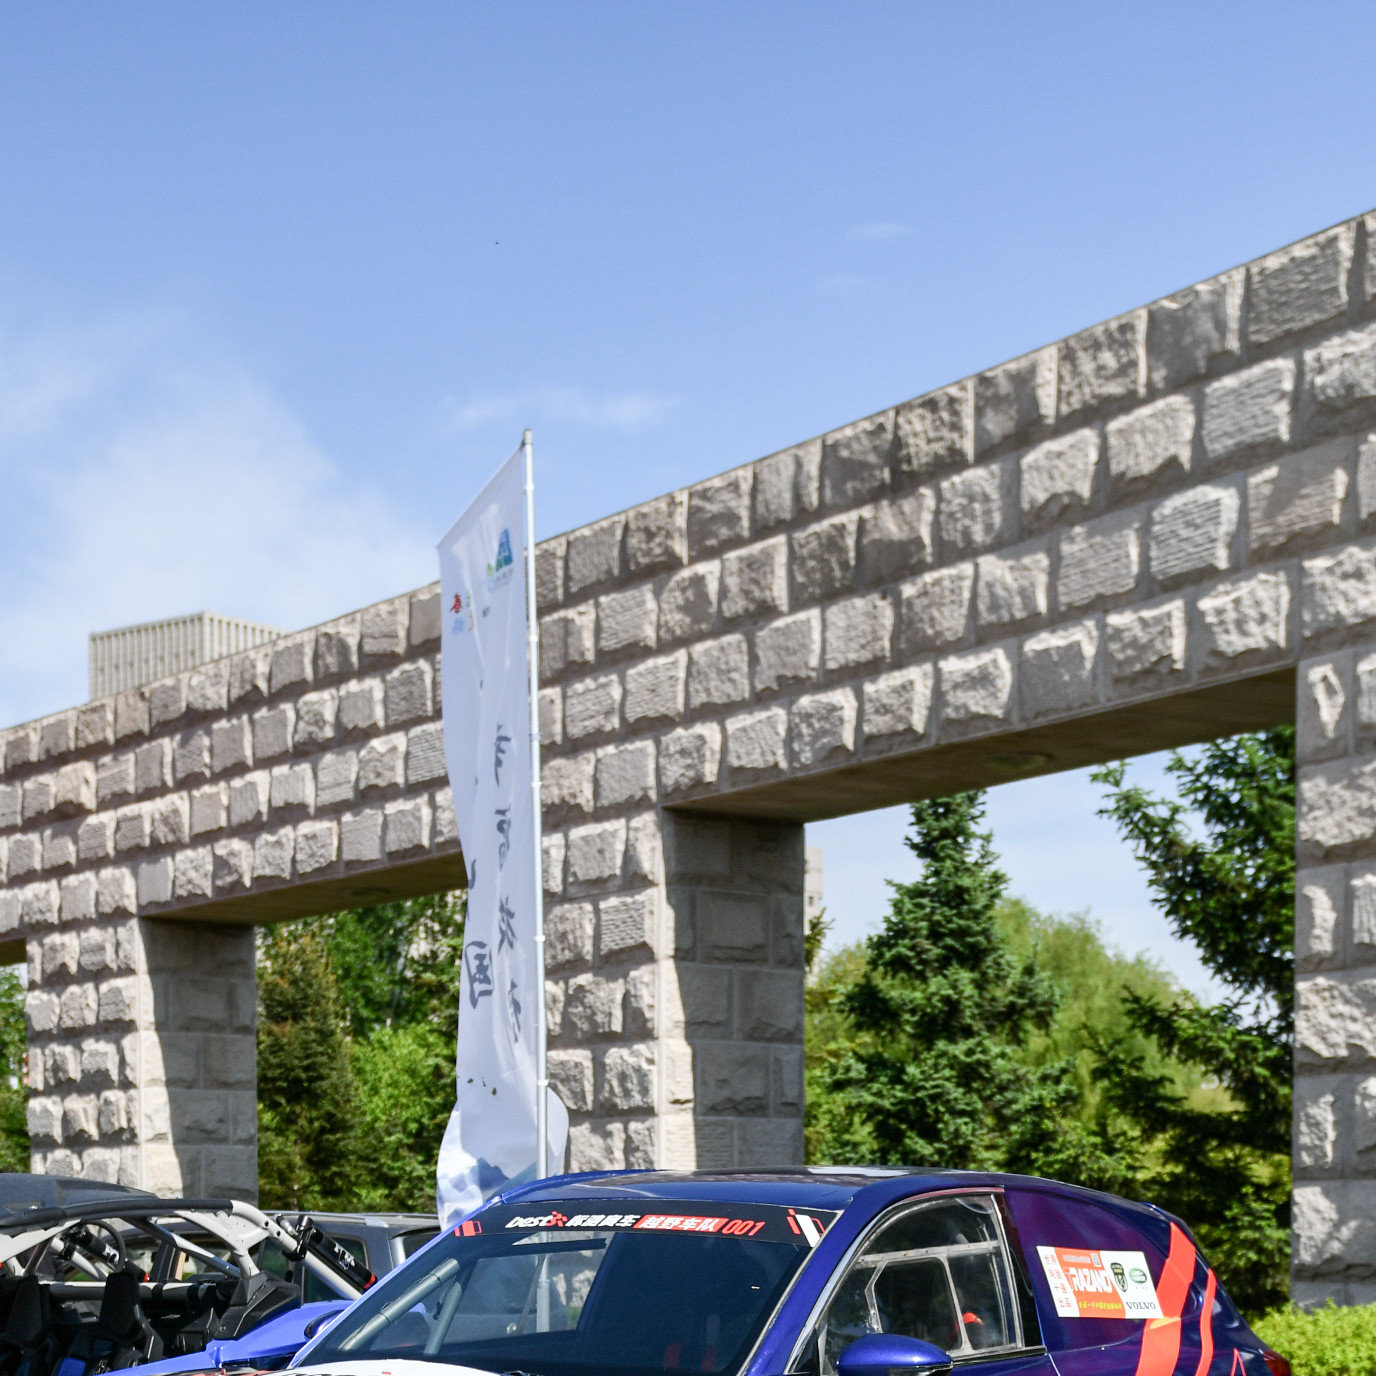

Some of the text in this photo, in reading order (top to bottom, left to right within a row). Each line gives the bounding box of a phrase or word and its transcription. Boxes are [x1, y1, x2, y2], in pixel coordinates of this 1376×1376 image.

[642, 1215, 720, 1231] 越野车队
[722, 1219, 766, 1236] 001
[1125, 1301, 1156, 1309] VOLVO
